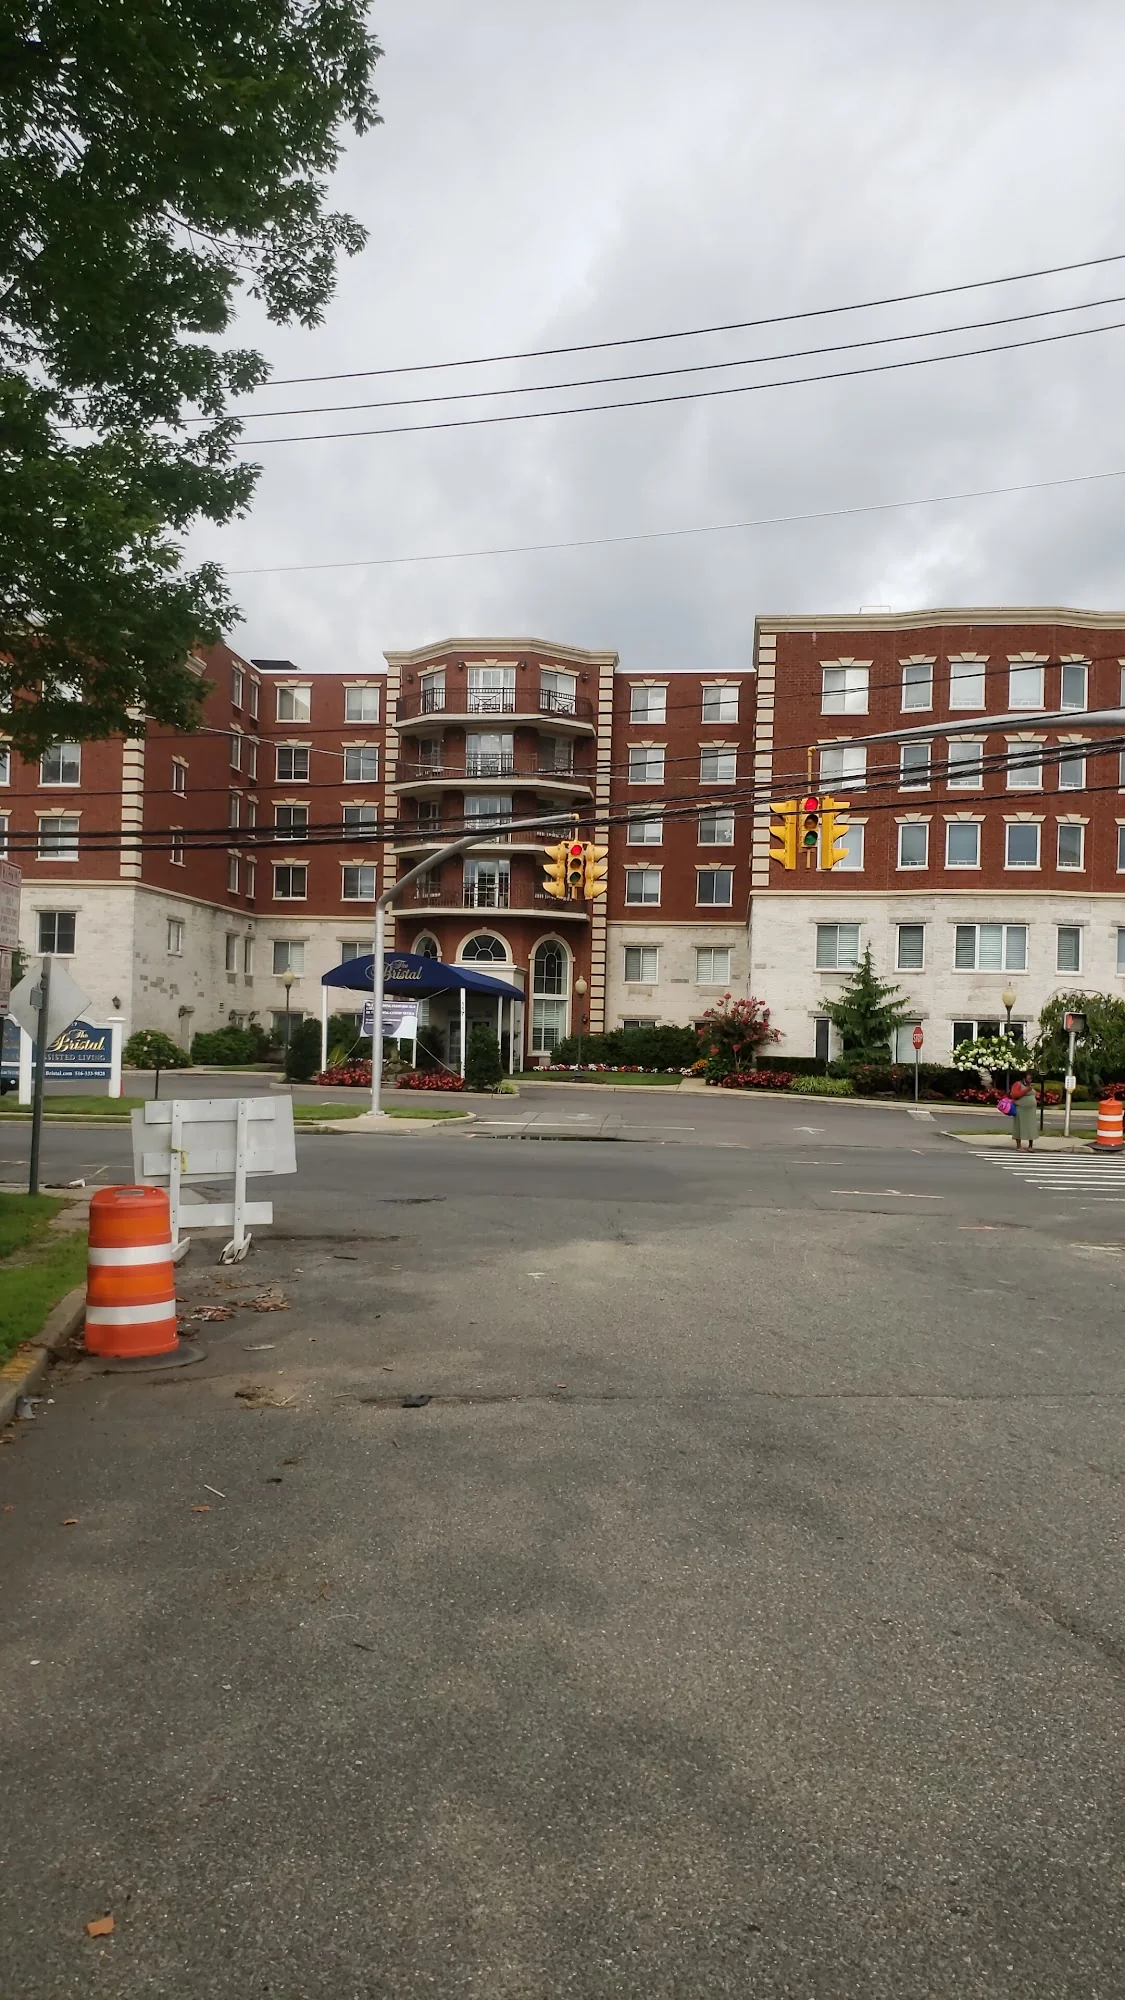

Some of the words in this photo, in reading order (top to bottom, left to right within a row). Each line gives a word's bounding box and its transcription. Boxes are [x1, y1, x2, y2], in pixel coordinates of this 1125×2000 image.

[365, 962, 423, 981] Bristal
[68, 1029, 88, 1038] The
[913, 1033, 923, 1043] STOP
[47, 1033, 105, 1052] Bristal
